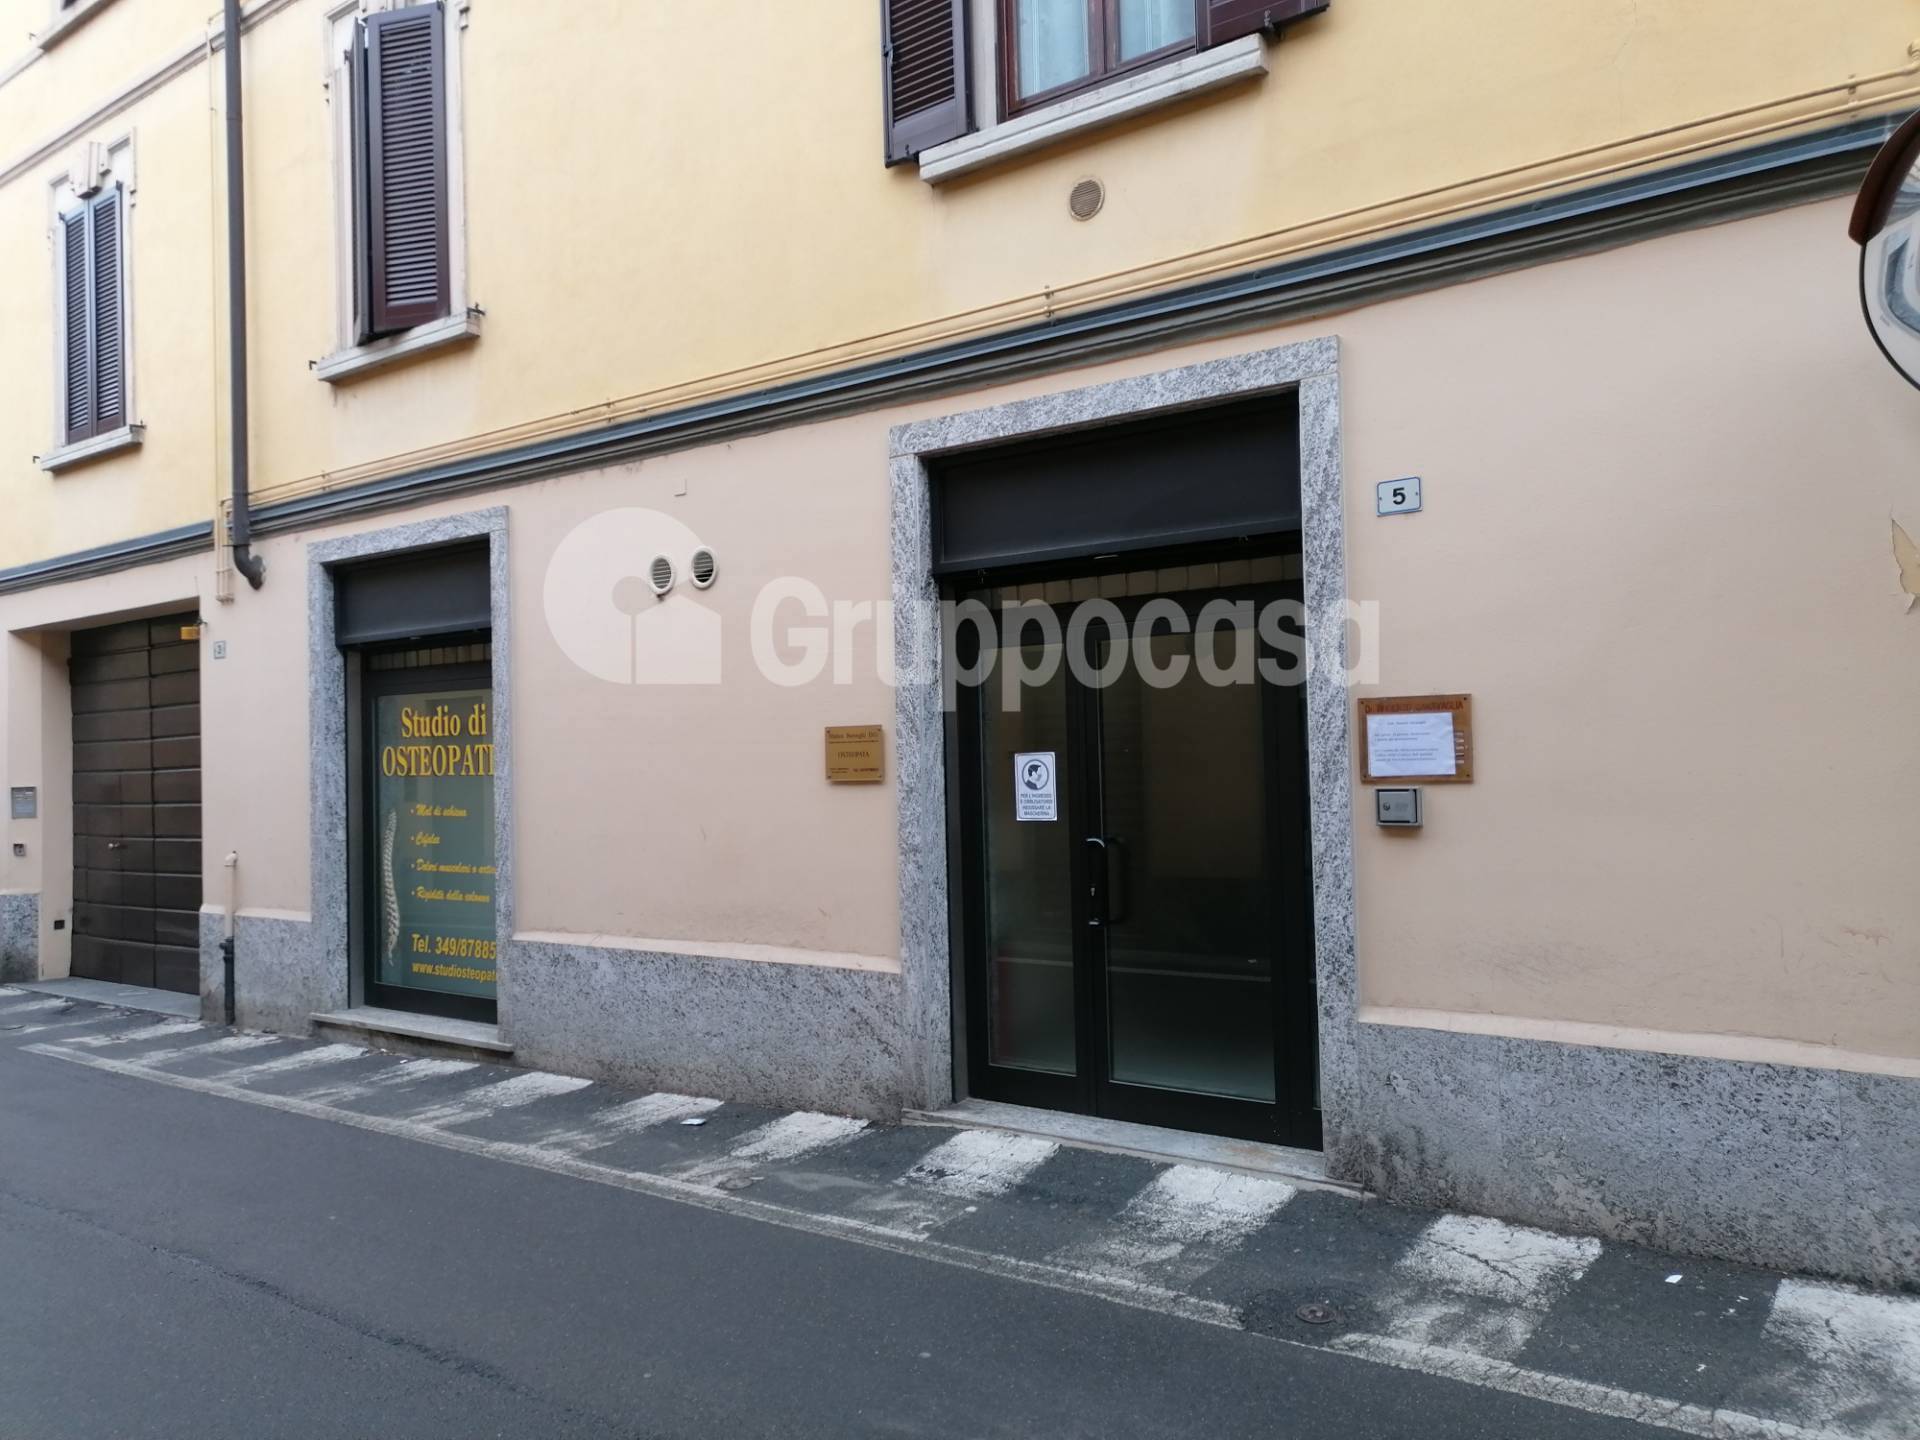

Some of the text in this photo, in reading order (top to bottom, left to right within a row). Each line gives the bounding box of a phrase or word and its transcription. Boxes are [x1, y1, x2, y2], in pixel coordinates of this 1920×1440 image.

[1392, 486, 1406, 505] 5
[401, 703, 487, 738] Studio di
[411, 933, 496, 960] Tel. 349/87885
